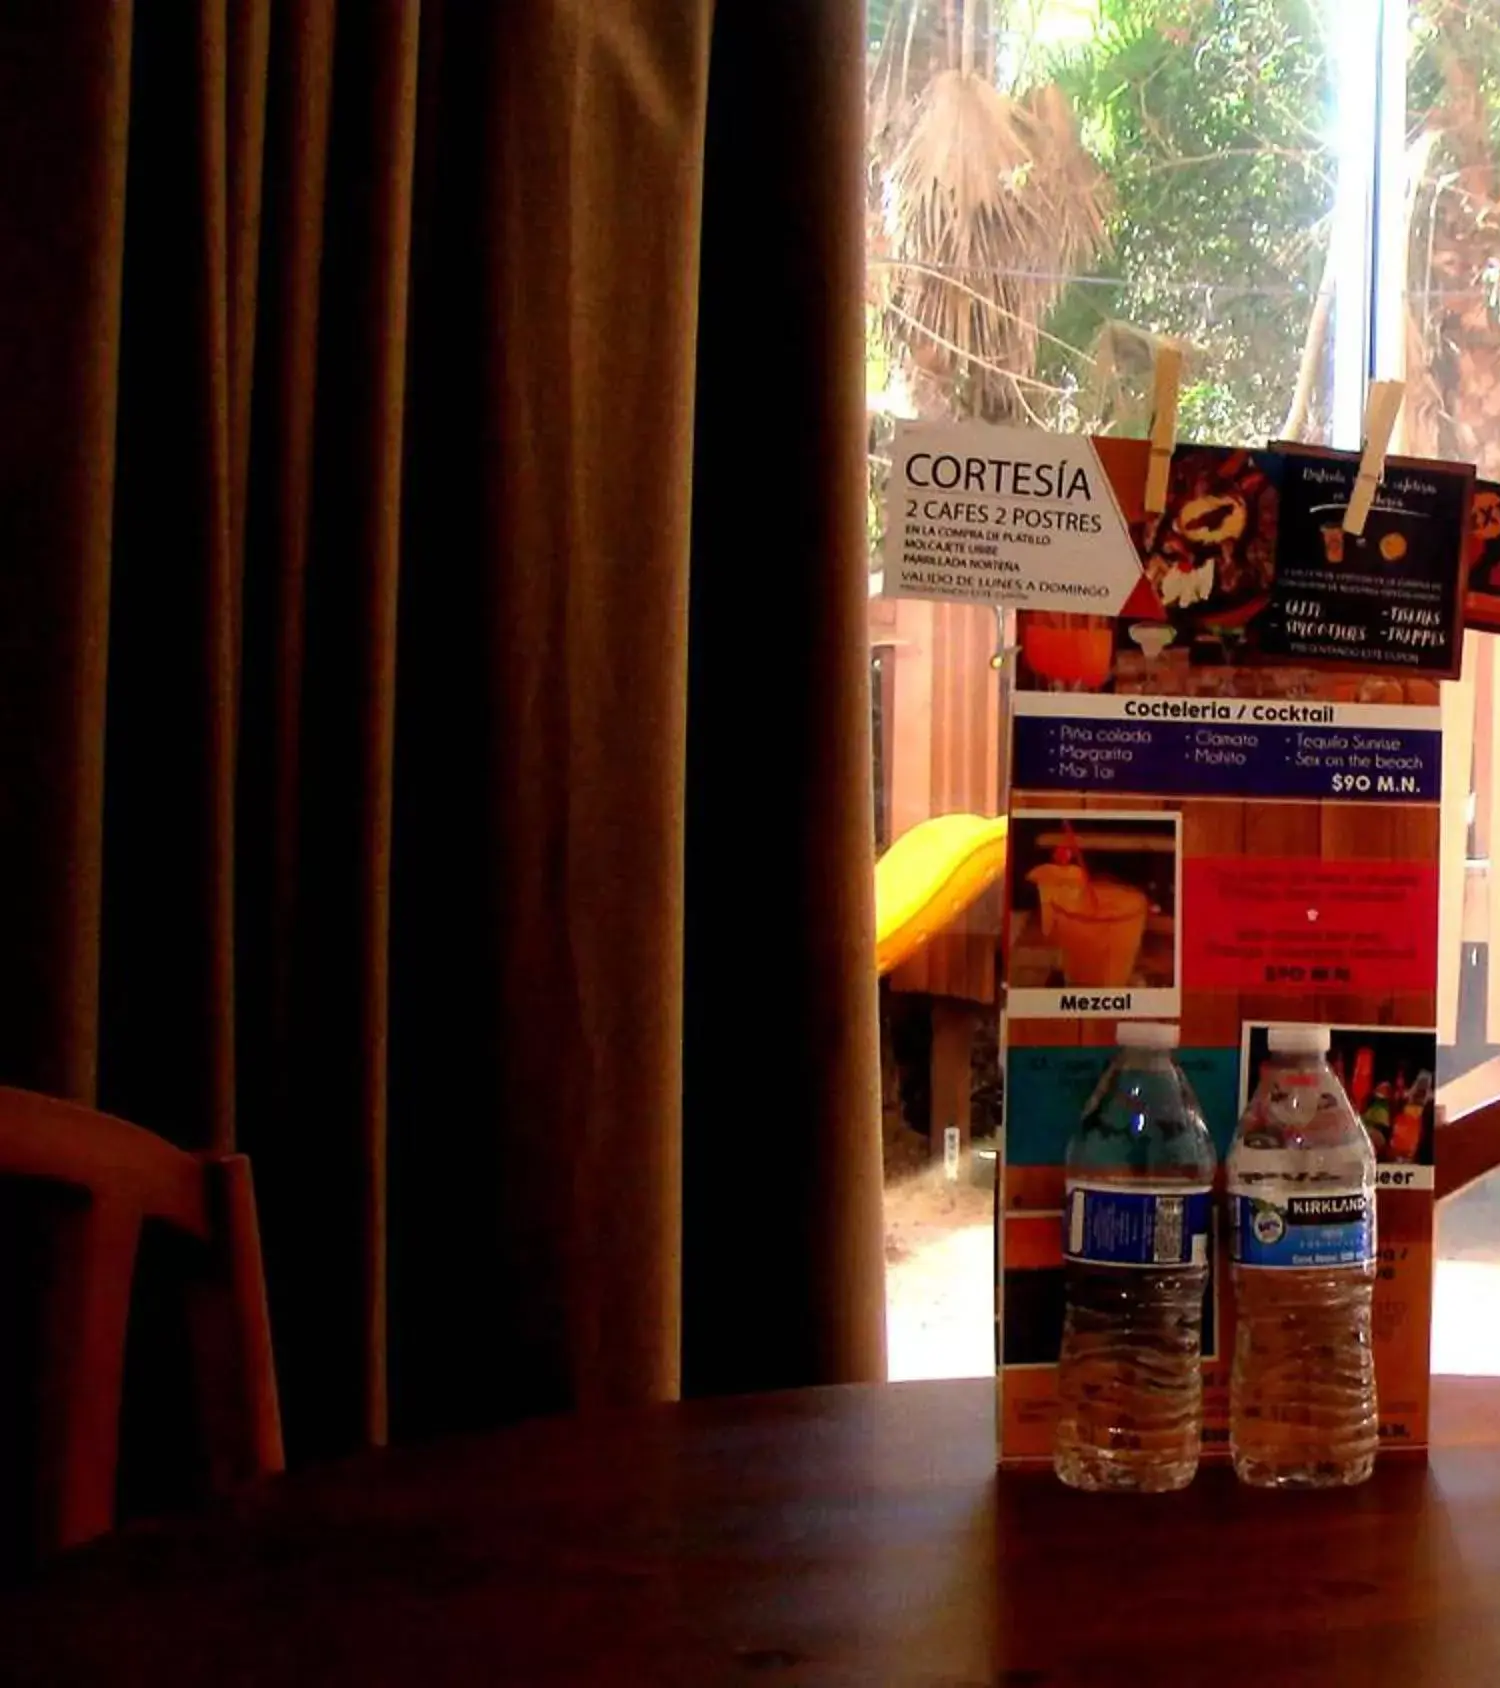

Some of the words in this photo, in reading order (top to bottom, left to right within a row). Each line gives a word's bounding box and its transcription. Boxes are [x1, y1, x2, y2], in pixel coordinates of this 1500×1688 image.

[906, 453, 1091, 500] CORTESÍA
[905, 500, 918, 518] 2
[923, 501, 989, 524] CAFES
[994, 507, 1007, 526] 2
[1012, 508, 1102, 533] POSTRES
[905, 524, 921, 536] EN
[922, 526, 936, 537] LA
[938, 527, 984, 541] COMPRA
[985, 531, 1000, 542] DE
[1002, 532, 1051, 546] PLATILLO
[904, 539, 966, 554] MOLCAJETE
[902, 553, 967, 568] PARRILLADA
[901, 570, 953, 586] VALIDO
[955, 575, 974, 588] DE
[977, 576, 1023, 590] LUNES
[1026, 580, 1036, 592] A
[1039, 582, 1110, 598] DOMINGO
[1237, 704, 1246, 720] /
[1252, 704, 1335, 723] Cocktail
[1095, 728, 1153, 745] colada
[1195, 729, 1260, 748] Clamato
[1352, 733, 1402, 752] Sunrise
[1059, 743, 1134, 764] Margarita
[1295, 751, 1320, 768] Sex
[1325, 755, 1345, 769] on
[1348, 753, 1372, 769] the
[1375, 753, 1424, 770] beach
[1058, 762, 1089, 780] Mai
[1093, 764, 1116, 780] Tai
[1331, 772, 1372, 793] $90
[1376, 774, 1421, 794] M.N.
[1060, 992, 1132, 1013] Mezcal
[1293, 1197, 1367, 1216] KIRKLAND
